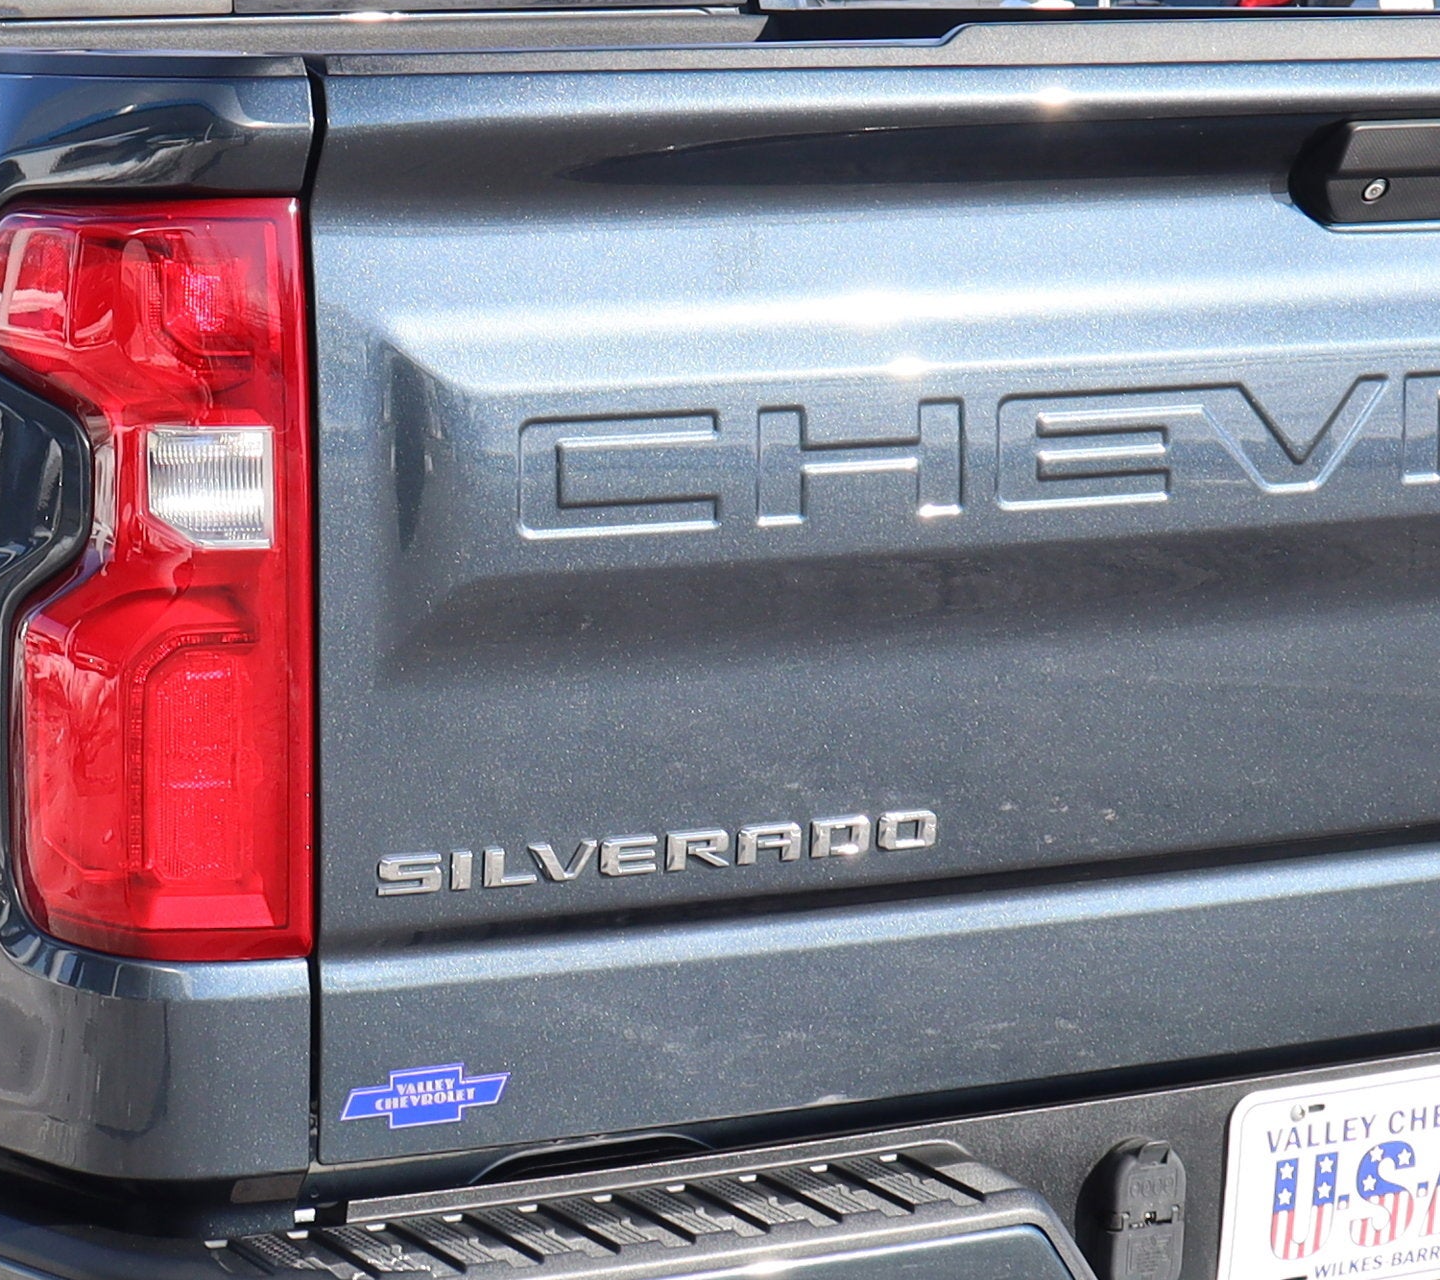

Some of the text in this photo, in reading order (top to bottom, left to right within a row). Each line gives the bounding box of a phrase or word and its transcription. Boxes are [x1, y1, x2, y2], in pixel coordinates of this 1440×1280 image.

[377, 809, 937, 896] SILVERADO
[374, 1087, 476, 1111] CHEVROLET
[396, 1078, 456, 1095] VALLEY
[1267, 1114, 1377, 1153] VALLEY
